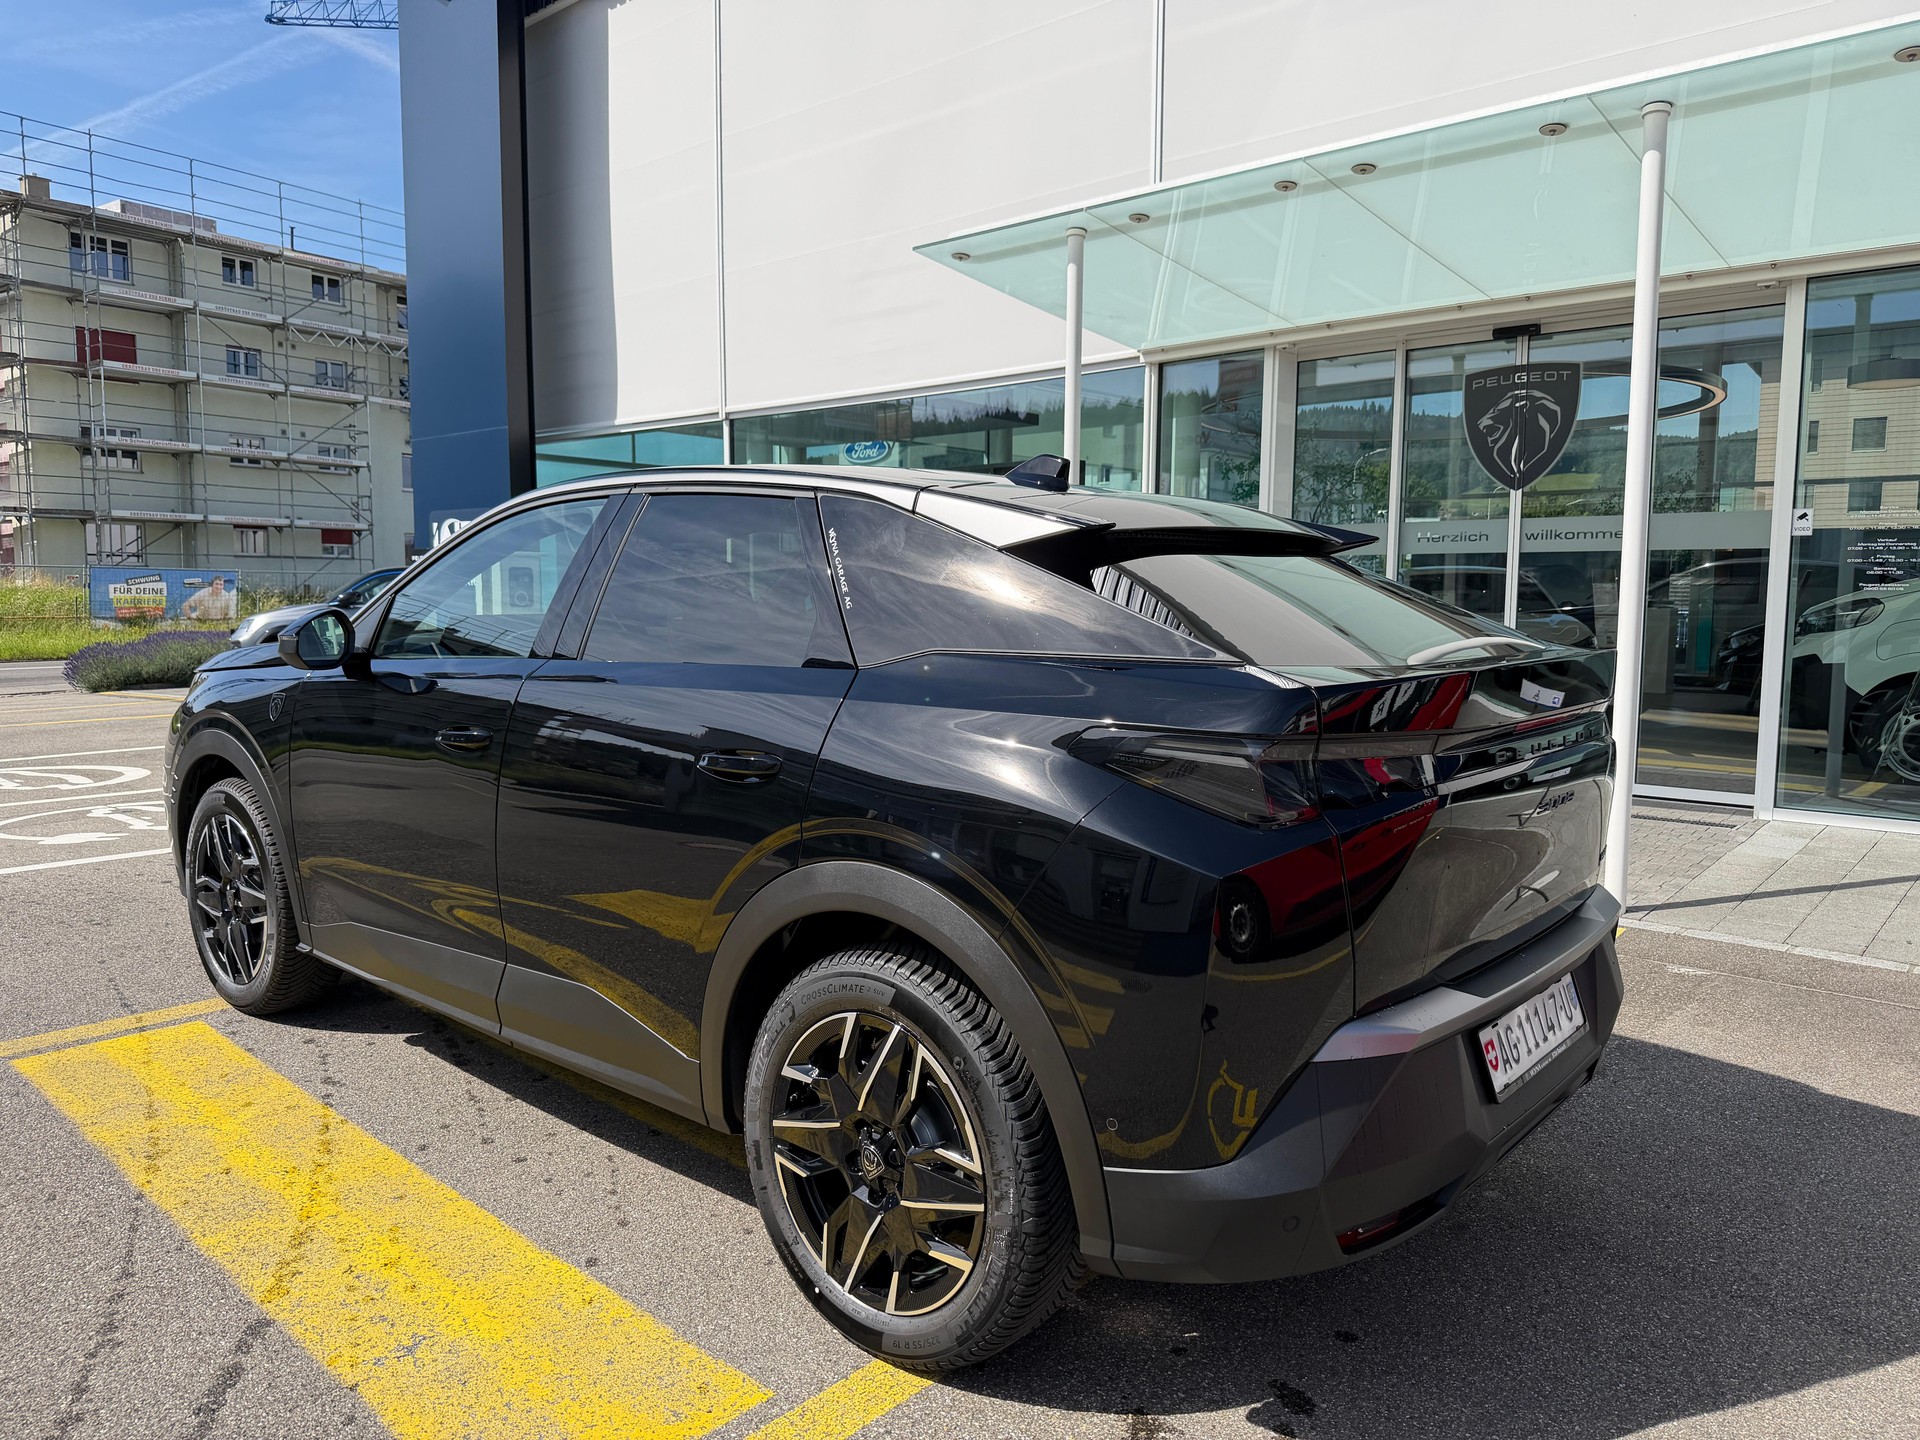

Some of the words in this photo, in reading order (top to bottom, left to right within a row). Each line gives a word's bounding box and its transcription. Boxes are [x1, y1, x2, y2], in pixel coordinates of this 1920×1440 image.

[1472, 370, 1572, 390] PEUGEOT
[852, 442, 880, 458] Ford
[1417, 531, 1488, 543] Herzlich
[1525, 529, 1623, 541] willkomme
[128, 575, 160, 585] SCHWUNG
[834, 558, 849, 594] GARAGE
[844, 596, 853, 610] AG
[114, 586, 134, 595] FÜR
[136, 587, 164, 595] DEINE
[116, 598, 164, 606] KARRIERE
[1495, 727, 1596, 763] PEUGEOT
[873, 988, 886, 997] SUV
[904, 1341, 910, 1349] R
[913, 1336, 940, 1349] 225/55
